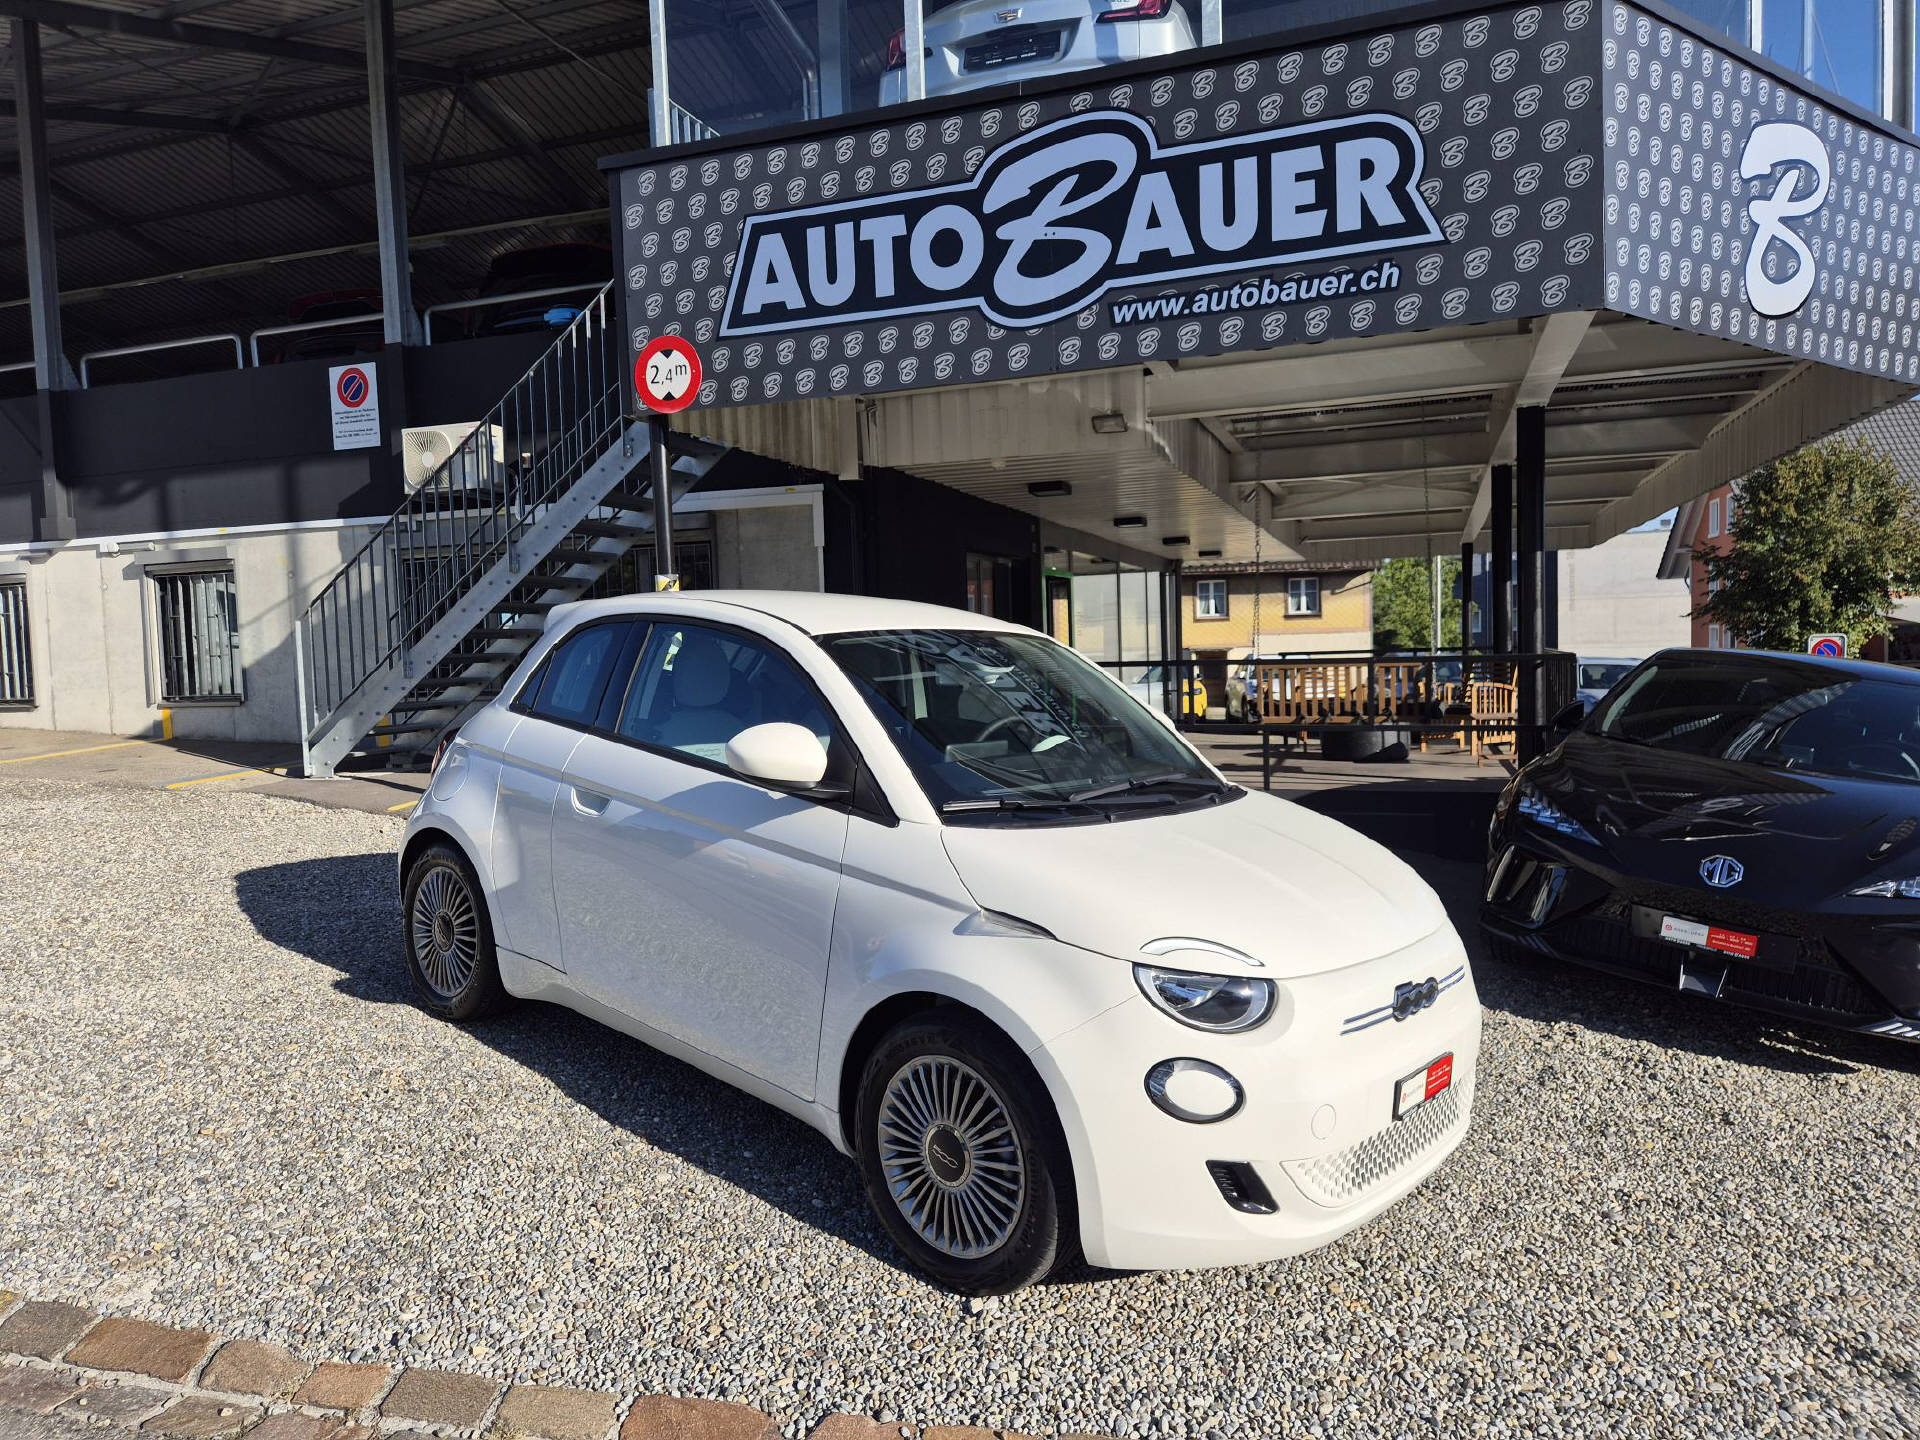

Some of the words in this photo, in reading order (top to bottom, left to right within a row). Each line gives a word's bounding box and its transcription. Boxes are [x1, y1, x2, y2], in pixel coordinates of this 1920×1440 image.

[1514, 7, 1541, 38] B
[1564, 1, 1591, 30] B
[1416, 25, 1441, 56] B
[1464, 17, 1489, 47] B
[1322, 45, 1347, 74] B
[1369, 35, 1393, 66] B
[1541, 42, 1568, 72] B
[1235, 62, 1258, 91] B
[1278, 53, 1302, 82] B
[1441, 60, 1467, 91] B
[1491, 50, 1518, 81] B
[1151, 77, 1174, 106] B
[1193, 70, 1215, 98] B
[1347, 77, 1372, 107] B
[1393, 69, 1419, 99] B
[1564, 77, 1592, 108] B
[1258, 94, 1282, 123] B
[1302, 86, 1327, 116] B
[1464, 95, 1490, 125] B
[1514, 86, 1541, 117] B
[981, 110, 1001, 137] B
[1018, 103, 1039, 129] B
[1174, 109, 1197, 138] B
[1216, 101, 1239, 130] B
[1416, 103, 1441, 133] B
[870, 130, 889, 156] B
[906, 123, 925, 149] B
[942, 117, 961, 143] B
[1541, 120, 1569, 151] B
[801, 143, 819, 168] B
[836, 137, 854, 163] B
[1441, 137, 1467, 167] B
[1492, 128, 1518, 159] B
[702, 160, 719, 185] B
[735, 155, 752, 179] B
[768, 149, 786, 173] B
[891, 160, 910, 186] B
[927, 154, 946, 180] B
[964, 147, 984, 173] B
[1565, 156, 1593, 187] B
[639, 171, 655, 195] B
[671, 166, 687, 190] B
[788, 178, 805, 203] B
[821, 172, 839, 197] B
[856, 167, 874, 191] B
[1464, 171, 1490, 202] B
[1514, 164, 1542, 194] B
[689, 194, 706, 218] B
[721, 189, 739, 214] B
[754, 184, 771, 208] B
[627, 205, 643, 228] B
[657, 199, 673, 223] B
[1492, 206, 1519, 236] B
[1541, 198, 1569, 229] B
[1741, 122, 1830, 316] B
[673, 228, 690, 252] B
[705, 223, 722, 247] B
[1442, 214, 1468, 242] B
[642, 233, 658, 257] B
[1514, 241, 1542, 271] B
[1565, 234, 1593, 264] B
[661, 262, 677, 285] B
[693, 257, 709, 281] B
[1417, 255, 1442, 284] B
[1464, 248, 1490, 278] B
[631, 265, 646, 289] B
[677, 290, 694, 313] B
[709, 286, 726, 310] B
[1113, 262, 1400, 324] www.autobauer.ch
[1442, 289, 1468, 318] B
[1492, 282, 1519, 312] B
[1541, 276, 1569, 306] B
[646, 294, 662, 317] B
[1078, 305, 1098, 328] B
[1350, 301, 1375, 330] B
[1396, 295, 1421, 324] B
[696, 319, 713, 342] B
[950, 318, 969, 343] B
[1220, 318, 1243, 345] B
[1262, 312, 1286, 340] B
[1306, 307, 1330, 335] B
[635, 327, 649, 350] B
[811, 336, 828, 359] B
[844, 332, 863, 357] B
[879, 328, 897, 352] B
[914, 323, 933, 348] B
[1099, 334, 1120, 359] B
[1138, 329, 1159, 355] B
[1178, 323, 1200, 350] B
[713, 348, 729, 371] B
[745, 344, 762, 367] B
[777, 340, 794, 363] B
[972, 349, 991, 374] B
[1009, 344, 1029, 370] B
[1060, 338, 1080, 364] B
[830, 365, 848, 389] B
[865, 361, 883, 385] B
[899, 358, 918, 382] B
[935, 354, 954, 378] B
[731, 377, 748, 400] B
[764, 373, 781, 397] B
[796, 369, 814, 393] B
[1701, 856, 1742, 886] MG
